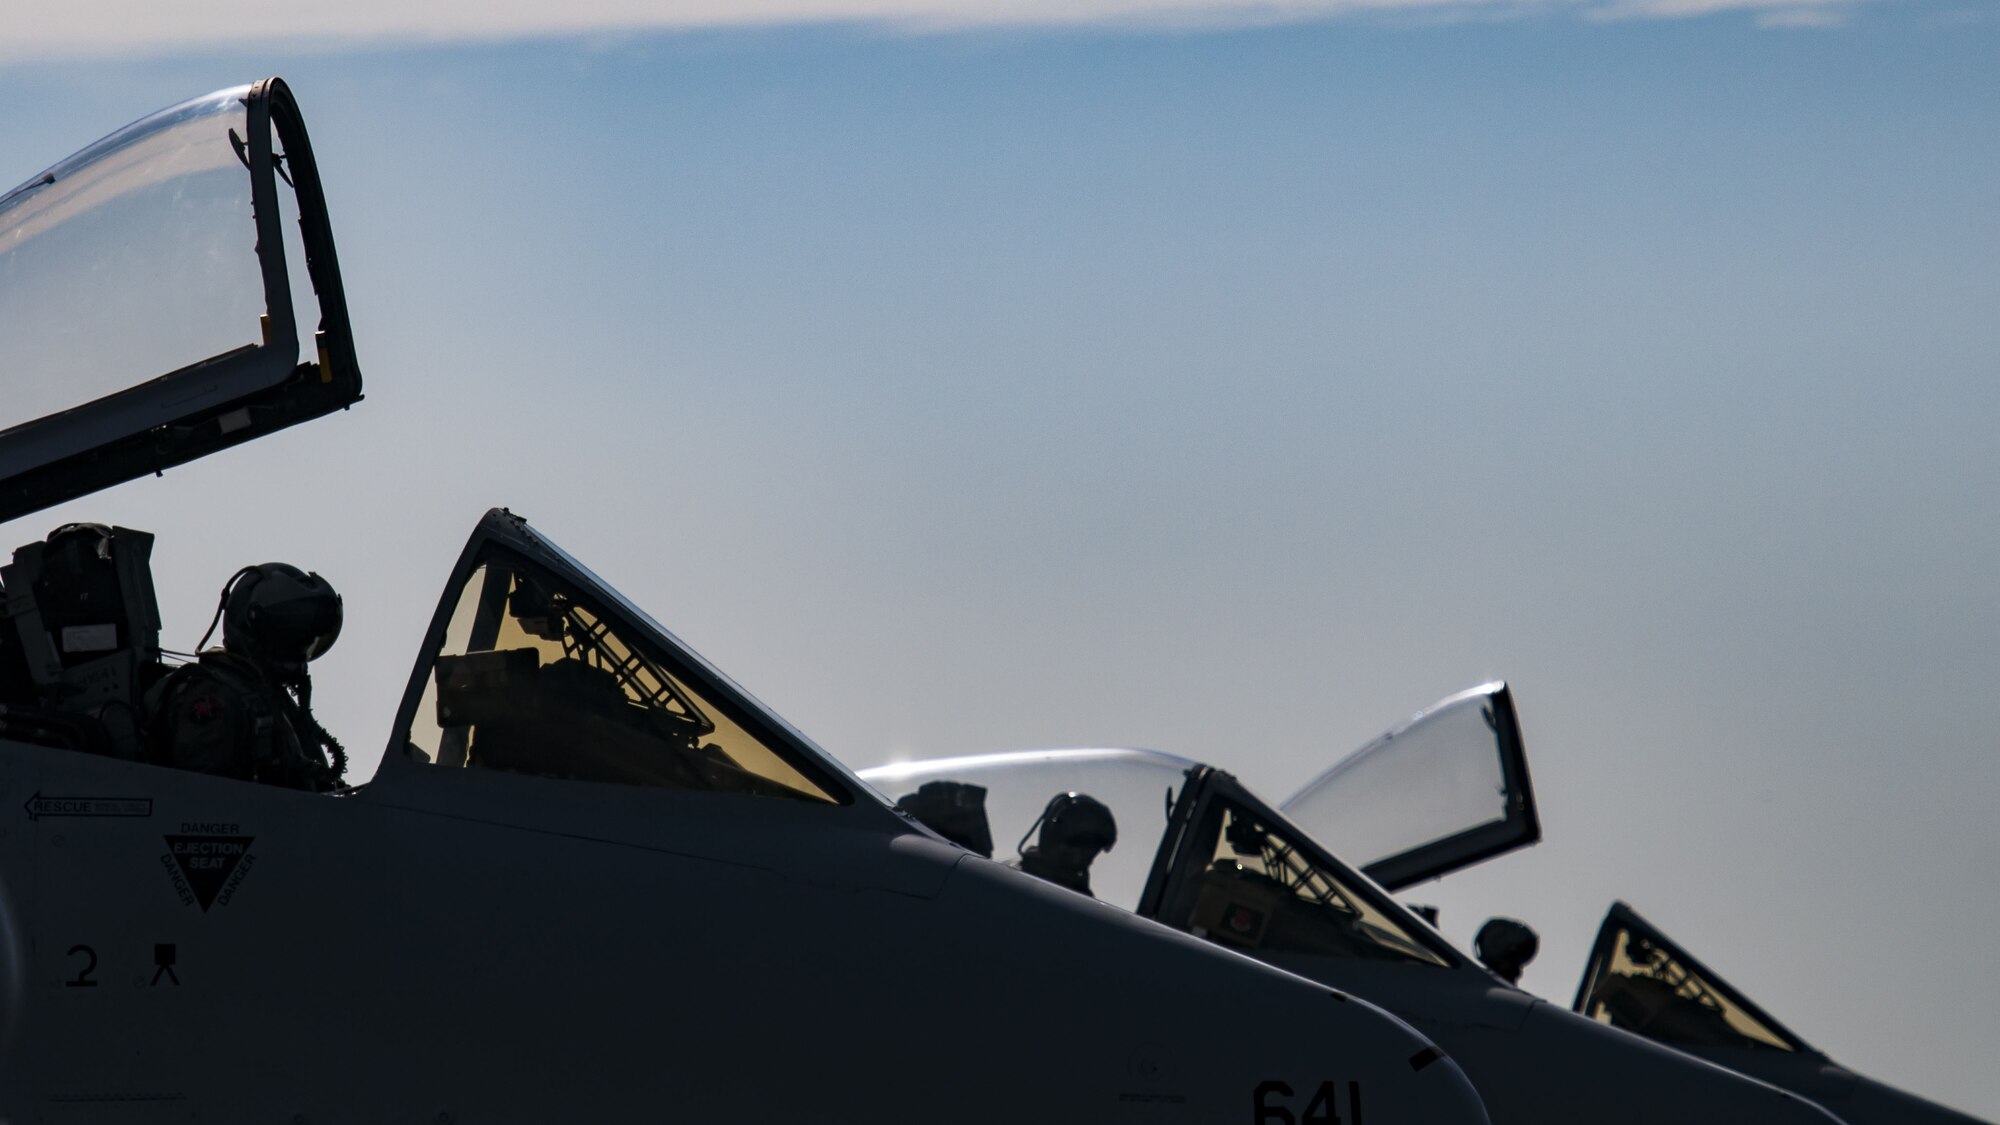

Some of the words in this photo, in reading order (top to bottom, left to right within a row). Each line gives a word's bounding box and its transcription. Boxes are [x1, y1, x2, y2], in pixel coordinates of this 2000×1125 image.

[33, 801, 92, 813] RESCUE
[181, 823, 240, 834] DANGER
[174, 842, 243, 855] EJECTION
[189, 856, 225, 869] SEAT
[160, 853, 195, 907] DANGER
[217, 853, 257, 907] DANGER
[1253, 1080, 1362, 1125] 641
